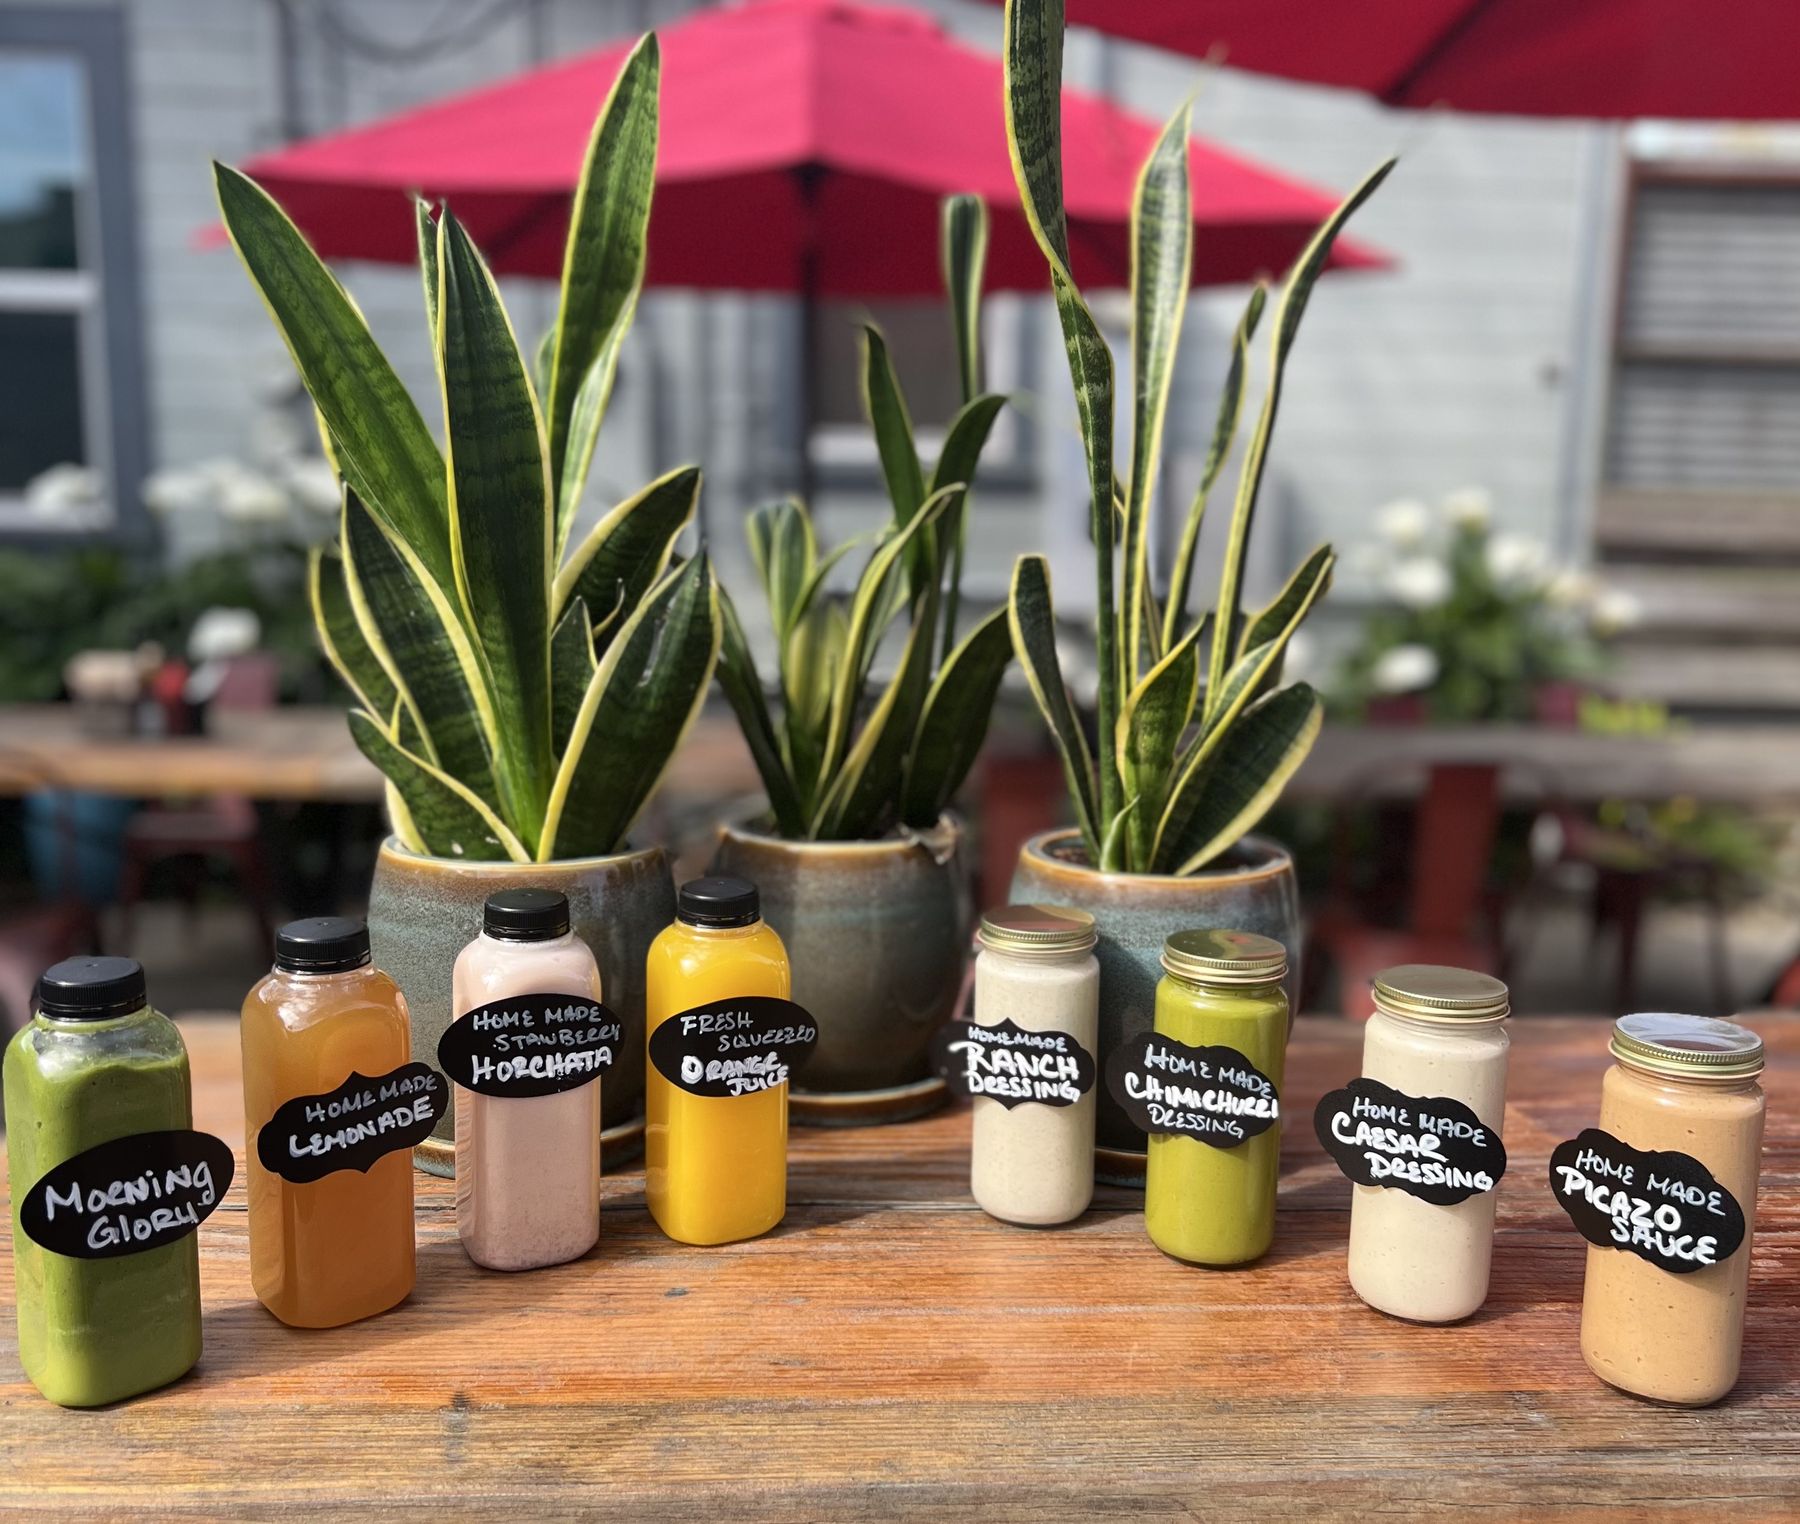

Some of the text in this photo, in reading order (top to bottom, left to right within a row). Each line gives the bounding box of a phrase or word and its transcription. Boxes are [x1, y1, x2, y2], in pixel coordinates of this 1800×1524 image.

[472, 1004, 602, 1031] HOME MADE
[680, 1011, 754, 1036] FRESH
[717, 1024, 816, 1052] SQUEEZED
[471, 1045, 613, 1085] HORCHATA
[680, 1051, 781, 1084] ORANGE
[726, 1064, 789, 1096] JUICE
[948, 1041, 1080, 1081] RANCH
[1144, 1043, 1273, 1100] HOME MADE
[305, 1074, 438, 1123] HOME MADE
[962, 1069, 1082, 1103] DRESSING
[1124, 1071, 1280, 1119] CHIMICHURRI
[289, 1095, 435, 1158] LEMONADE
[1147, 1102, 1244, 1140] DRESSING
[1331, 1111, 1450, 1163] CAESAR
[1352, 1096, 1487, 1147] HOME MADE
[1363, 1151, 1494, 1193] DRESSING
[1575, 1148, 1727, 1216] HOME MADE
[1555, 1165, 1682, 1232] PICAZO
[1609, 1215, 1718, 1265] SAUCE
